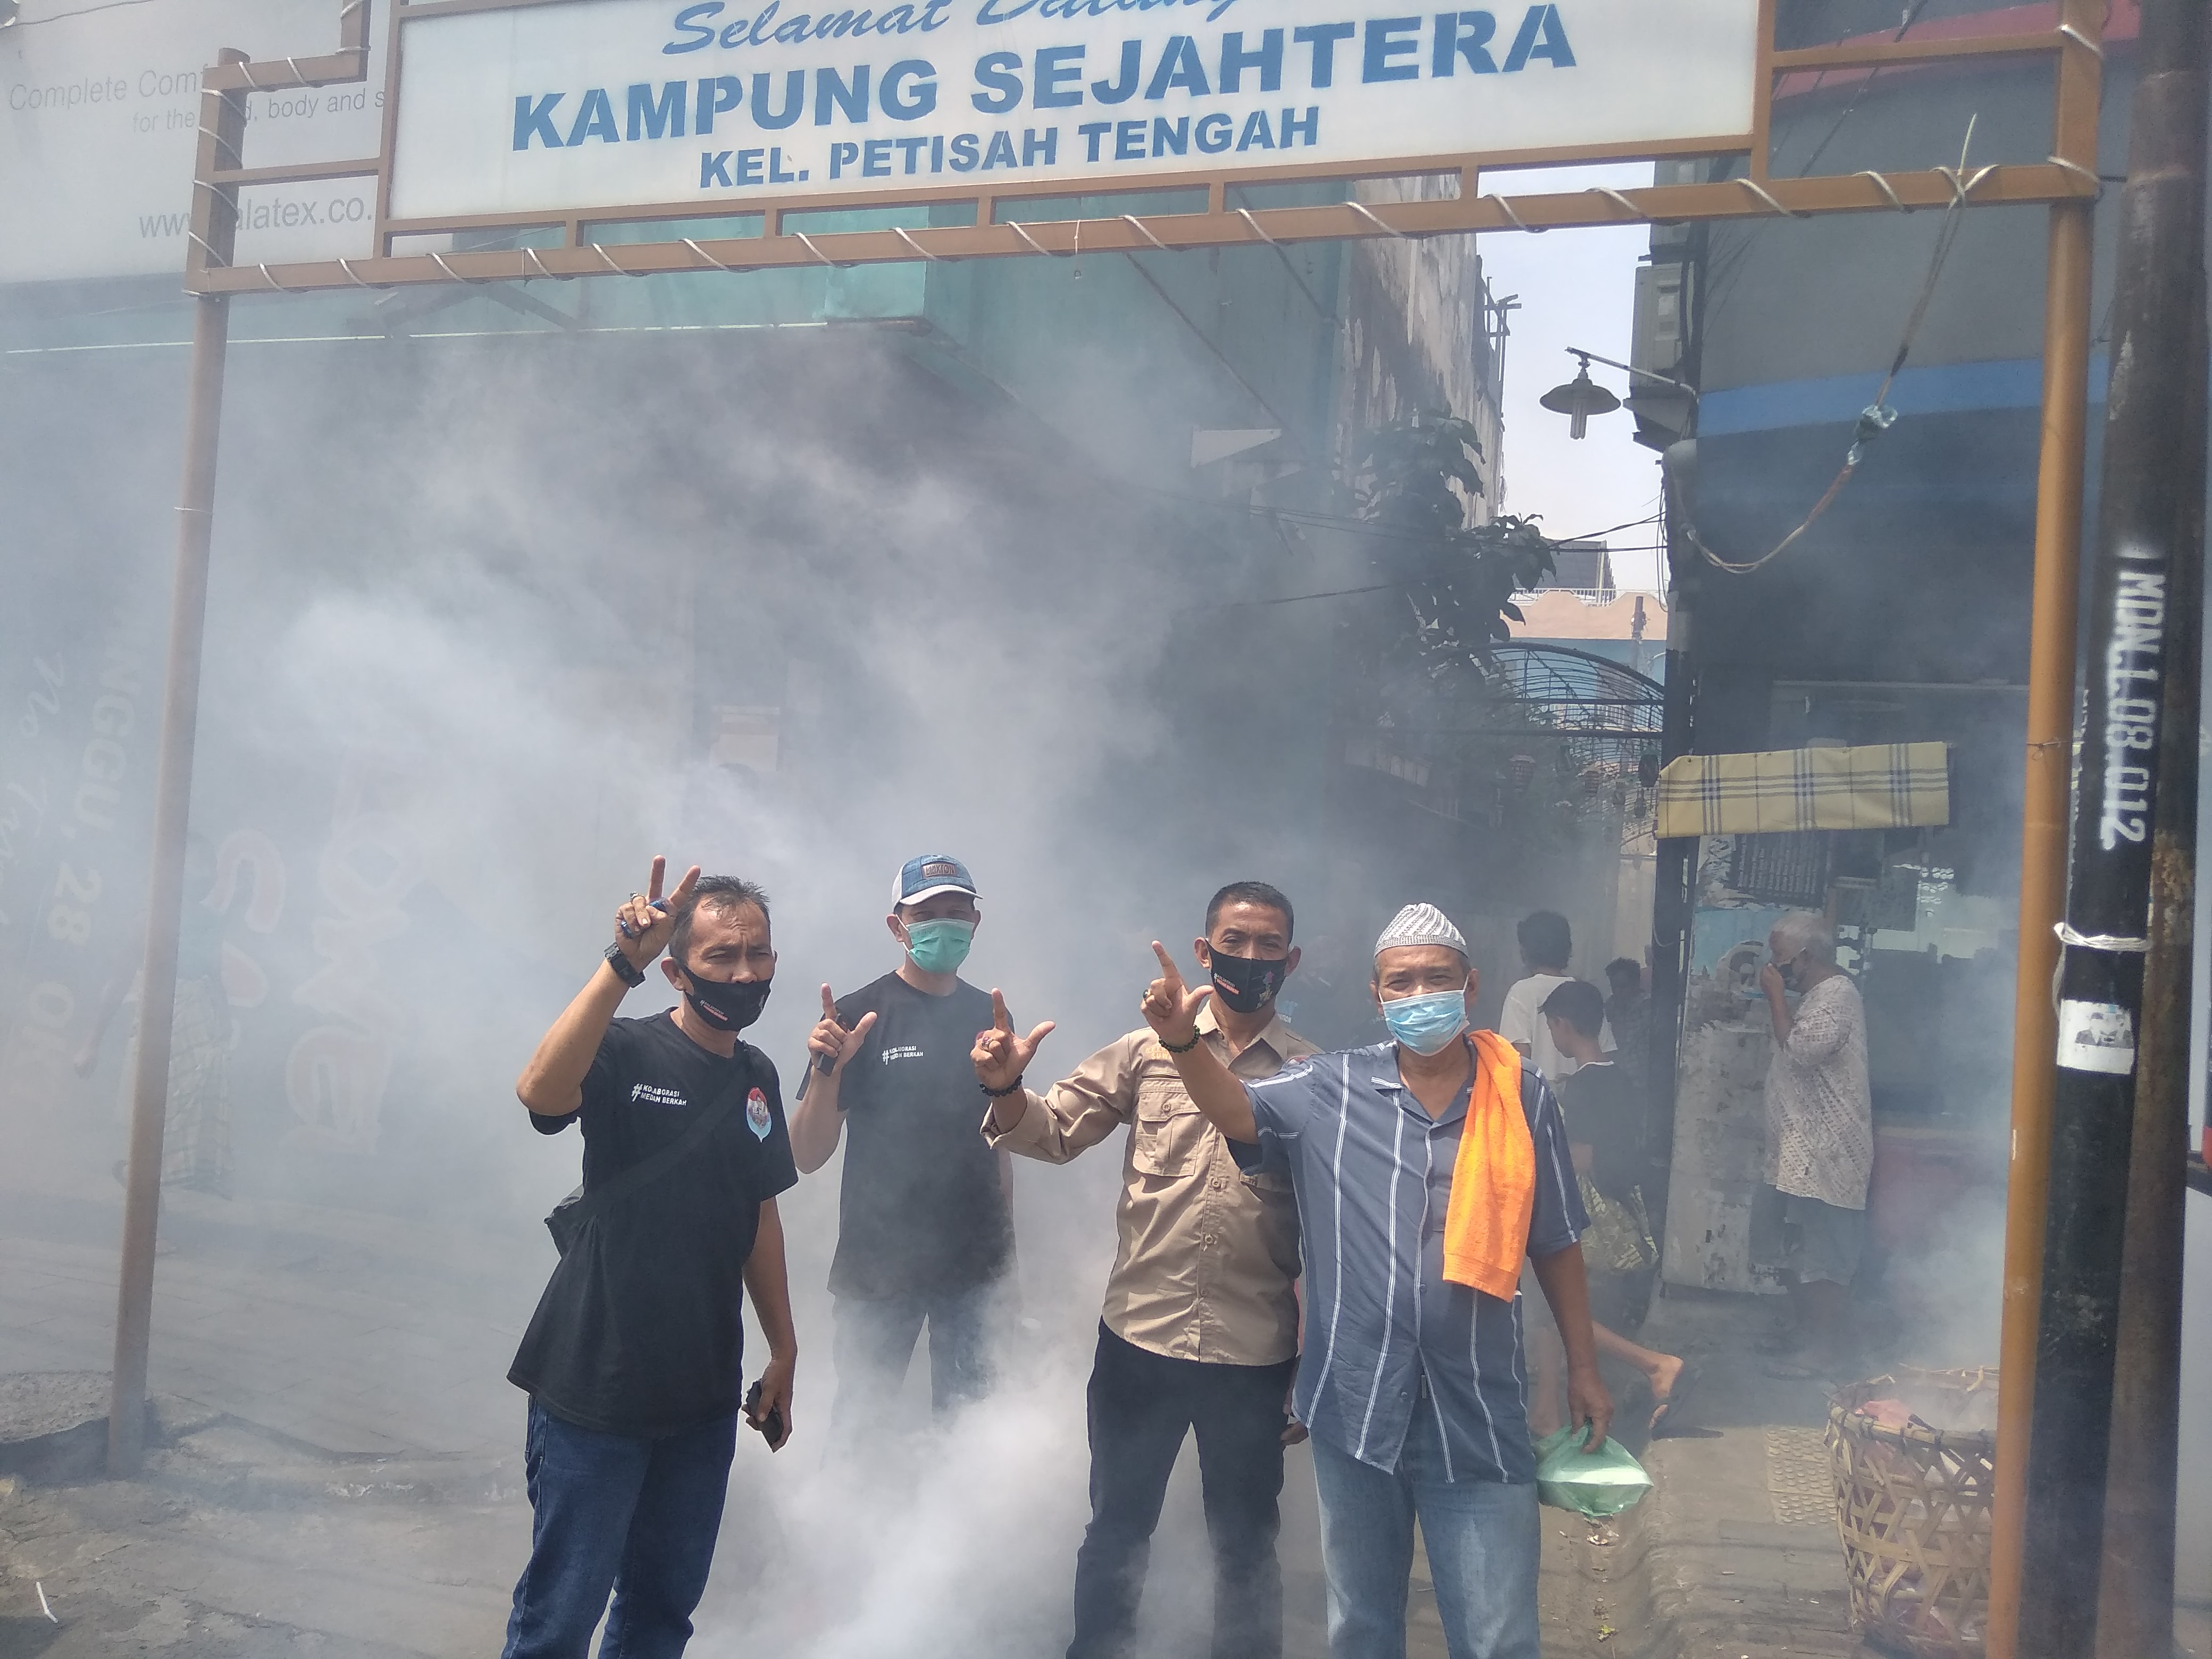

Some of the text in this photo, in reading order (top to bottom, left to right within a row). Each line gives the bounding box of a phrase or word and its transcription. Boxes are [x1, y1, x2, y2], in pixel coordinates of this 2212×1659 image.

[663, 0, 951, 54] Selamat
[10, 64, 208, 110] Complete Com
[514, 4, 1576, 150] KAMPUNG SEJAHTERA
[133, 112, 158, 133] for
[166, 109, 195, 130] the
[268, 94, 319, 119] body
[328, 88, 366, 113] and
[700, 106, 1319, 188] KEL. PETISAH TENGAH
[662, 1096, 687, 1106] BERKAH
